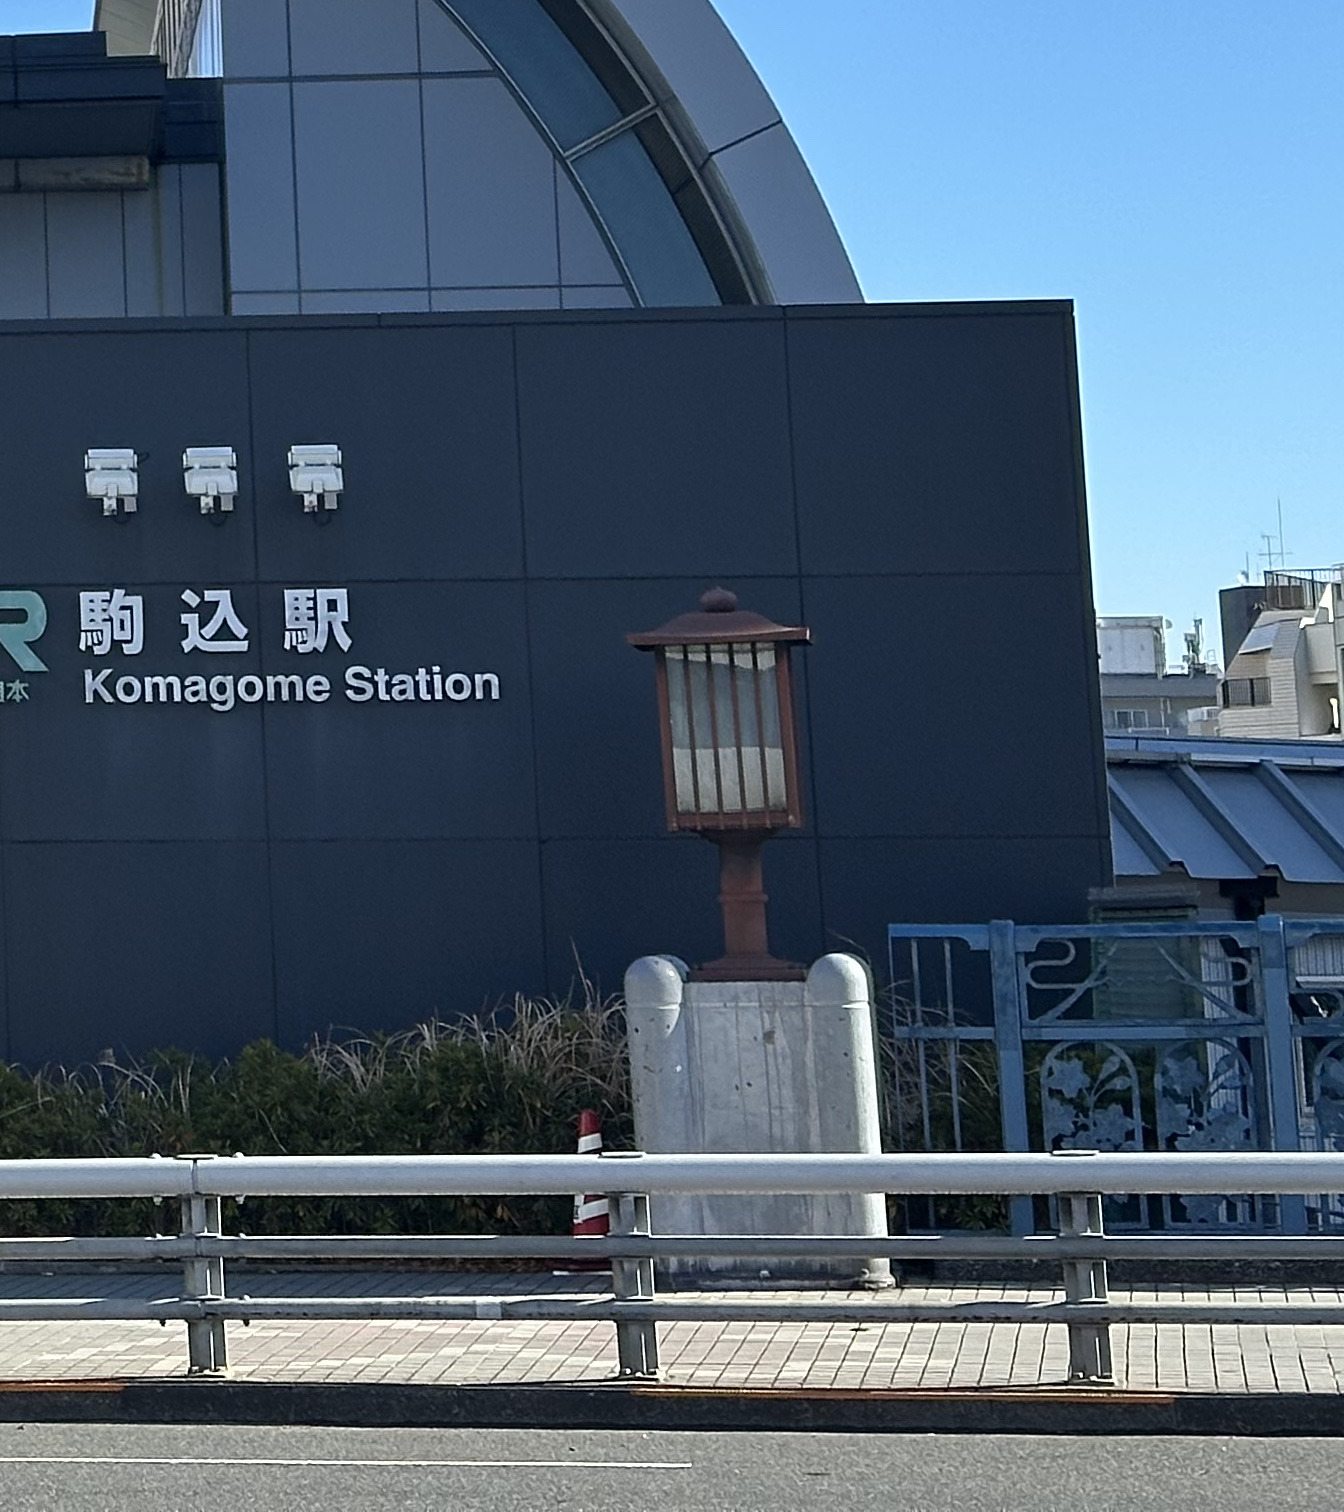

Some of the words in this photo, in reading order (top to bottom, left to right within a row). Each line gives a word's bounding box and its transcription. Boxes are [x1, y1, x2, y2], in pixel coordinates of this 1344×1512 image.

[78, 588, 353, 656] 駒込駅
[83, 668, 331, 712] Komagome
[344, 664, 502, 704] Station
